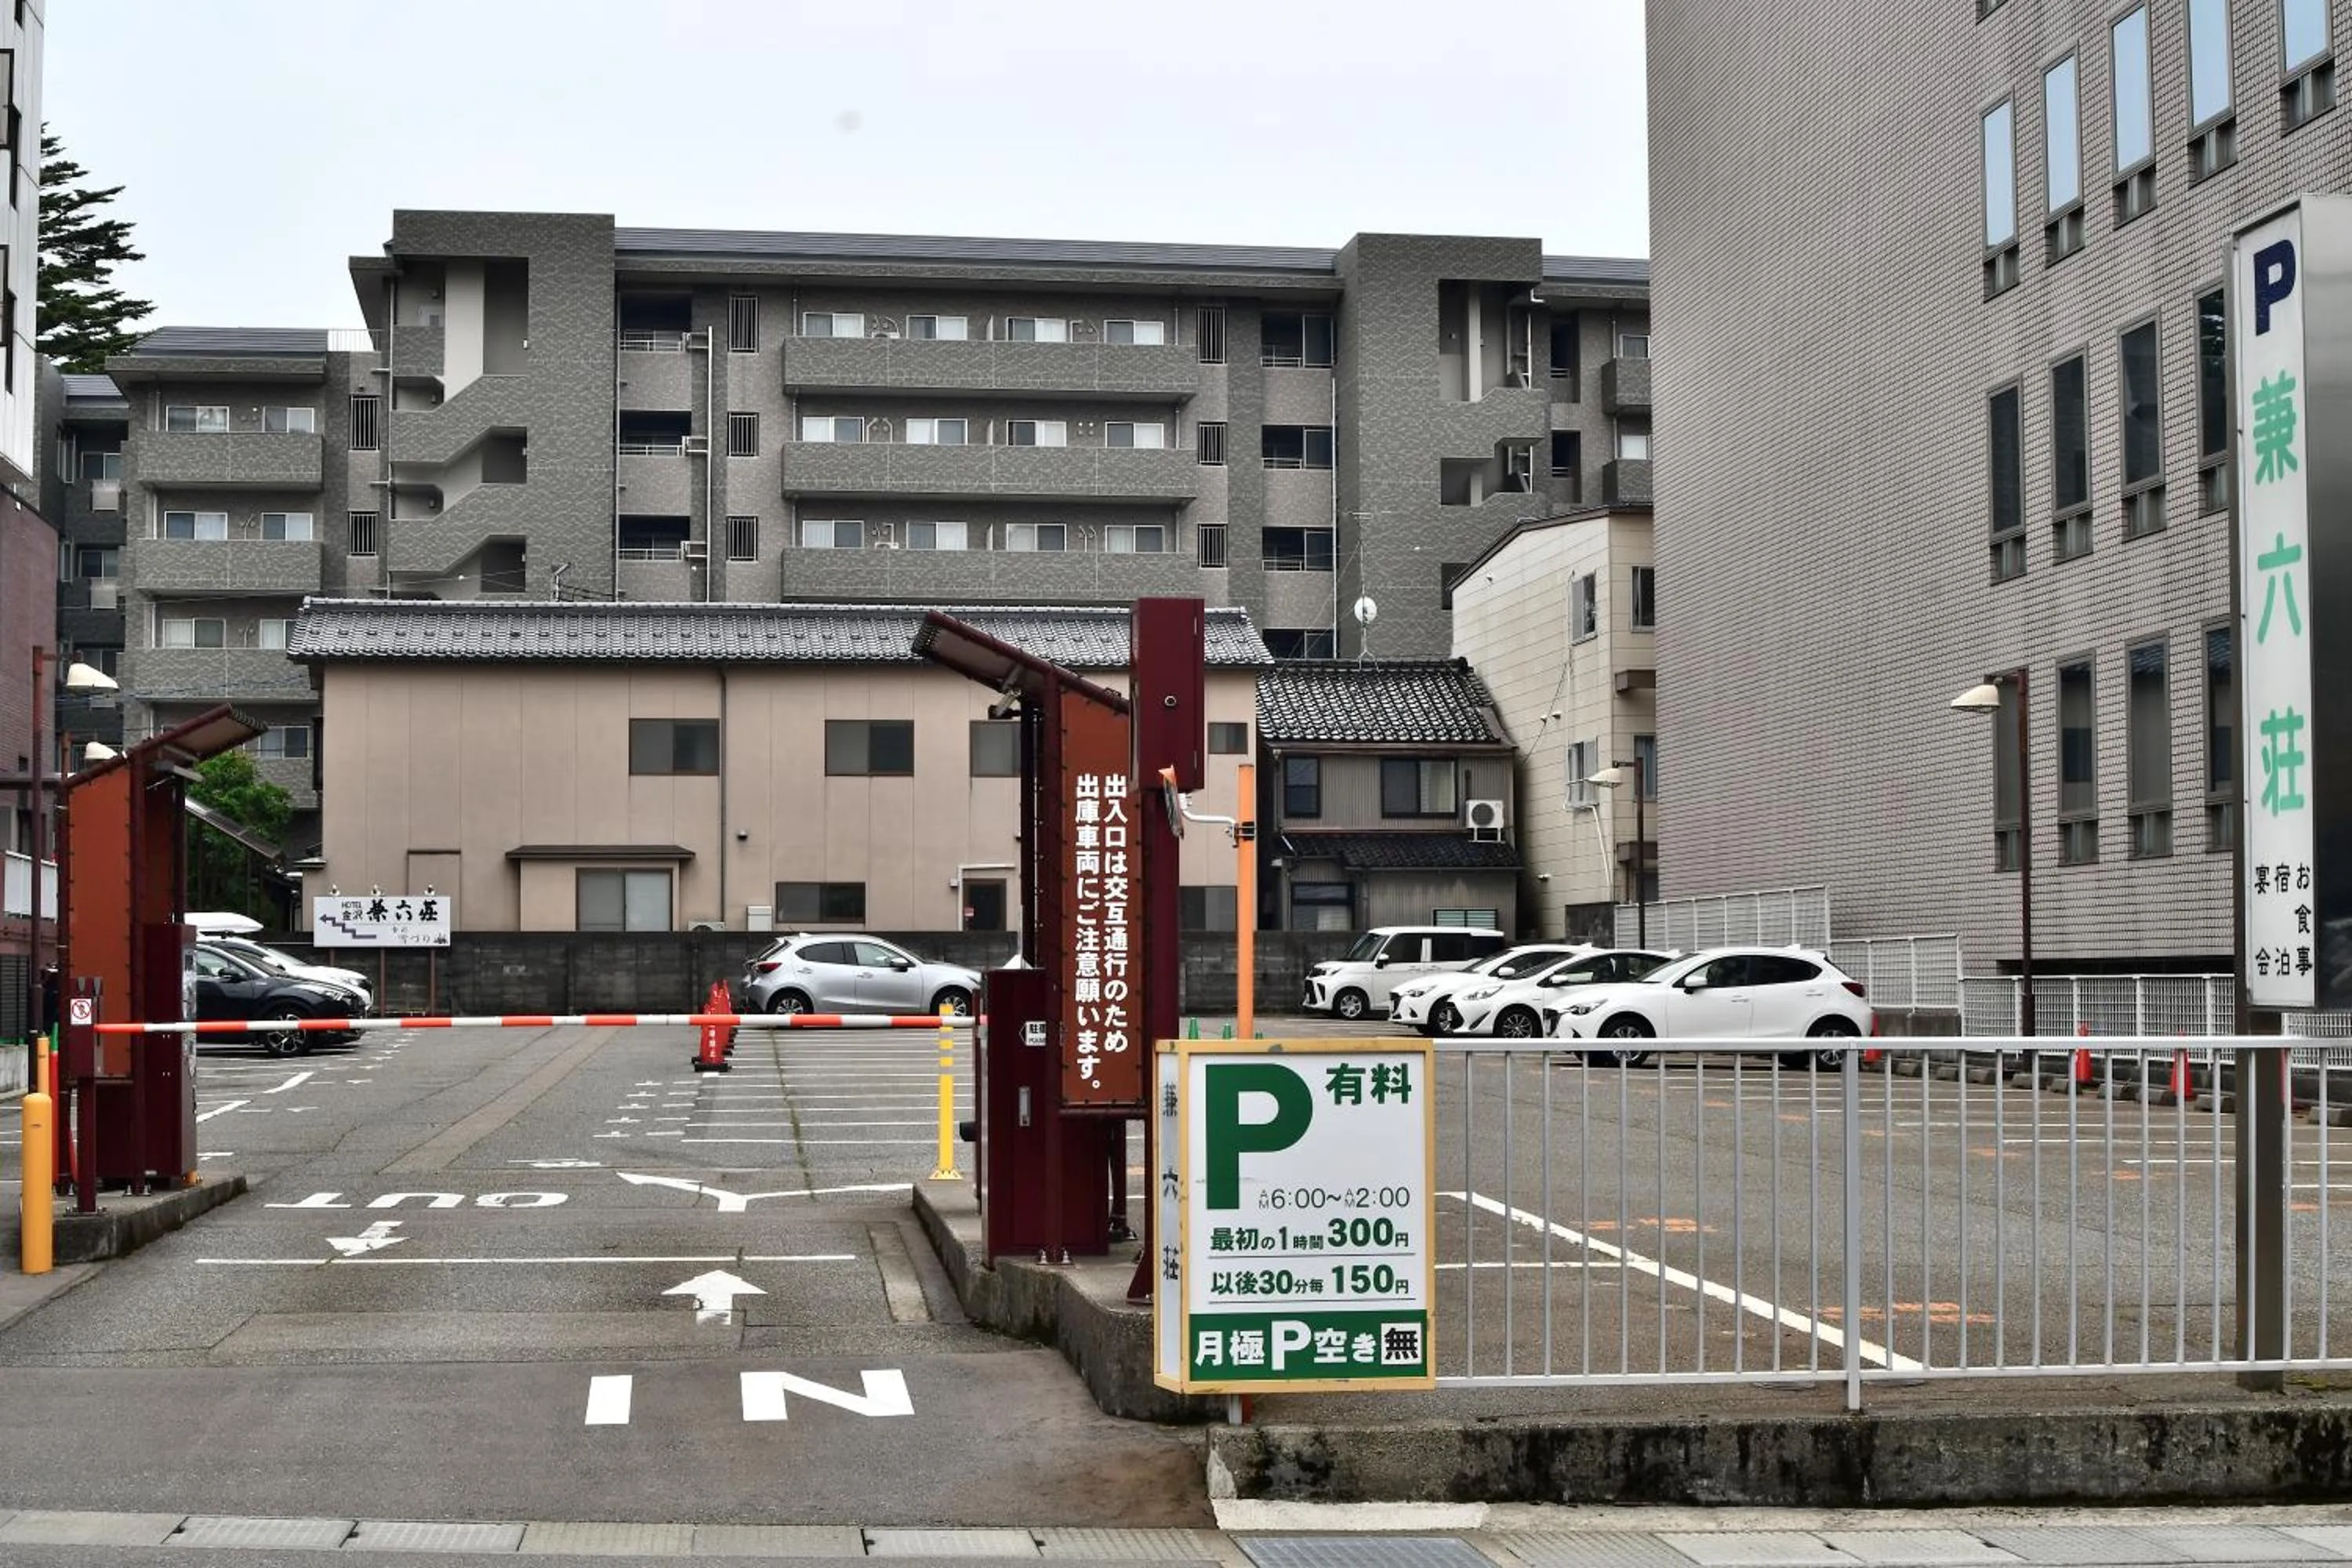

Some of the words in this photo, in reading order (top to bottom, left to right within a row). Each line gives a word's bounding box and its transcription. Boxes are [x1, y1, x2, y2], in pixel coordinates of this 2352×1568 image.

[2253, 238, 2296, 336] P
[2252, 368, 2307, 818] 兼六荘
[1075, 773, 1101, 1089] 出庫車両にご注意願います。
[1104, 773, 1127, 1053] 出入口は交互通行のため
[2255, 864, 2271, 976] 宴会
[2274, 862, 2291, 976] 宿泊
[2294, 862, 2314, 977] お食事
[1205, 1064, 1313, 1209] P
[1326, 1062, 1411, 1105] 有料
[1195, 1319, 1419, 1370] 月極P空き無
